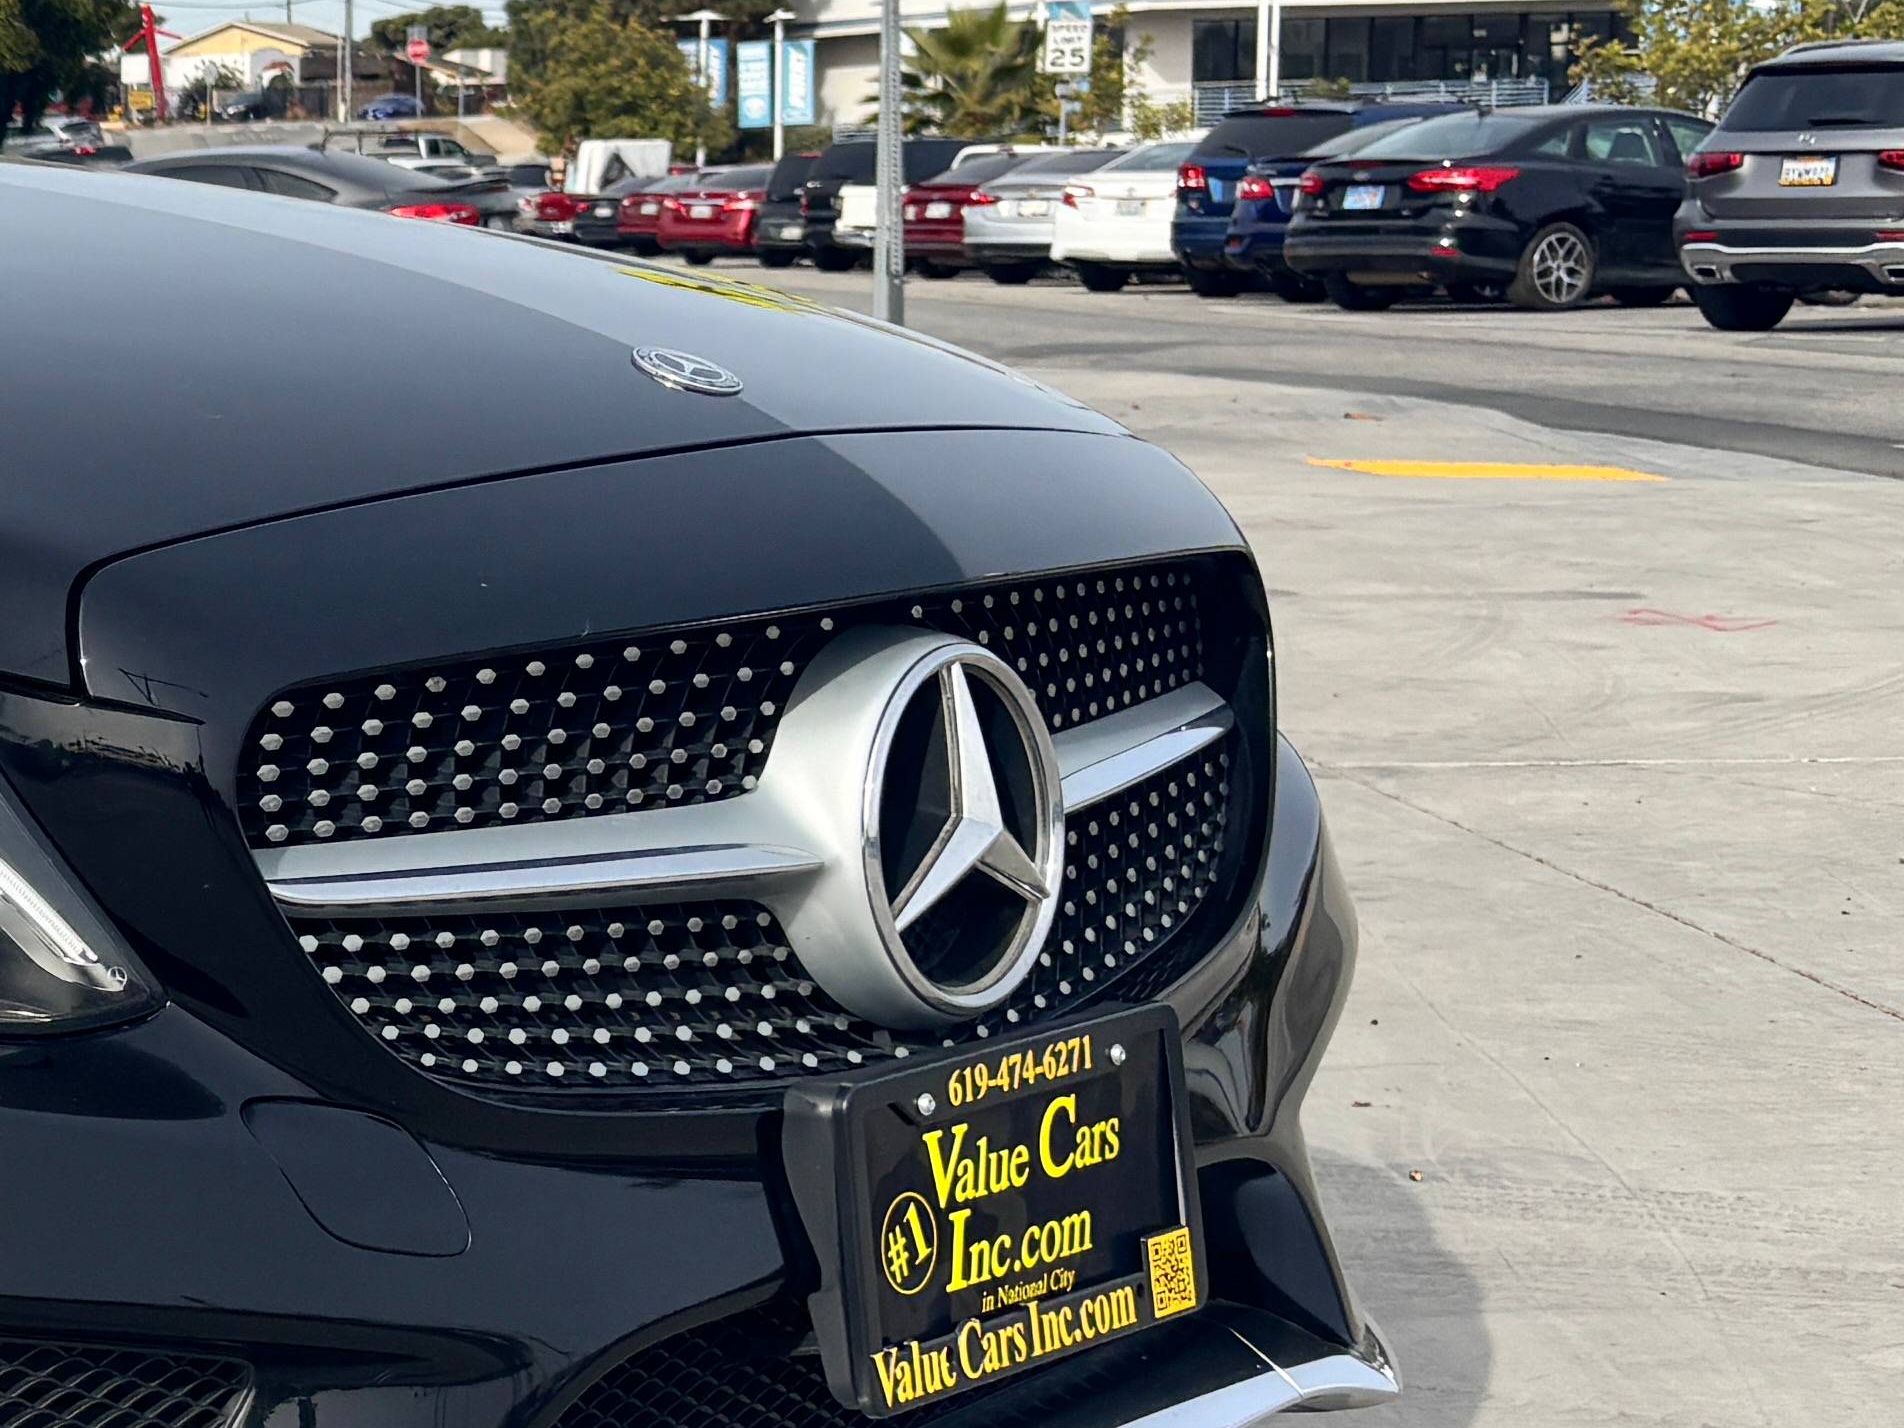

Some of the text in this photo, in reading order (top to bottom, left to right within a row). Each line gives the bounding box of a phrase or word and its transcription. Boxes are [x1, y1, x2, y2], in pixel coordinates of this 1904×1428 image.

[1050, 48, 1084, 67] 25
[949, 1035, 1093, 1107] 619-474-6271
[922, 1093, 1120, 1209] Value Cars
[888, 1201, 933, 1284] #1
[945, 1208, 1093, 1293] Inc.com
[981, 1268, 1075, 1313] in National City
